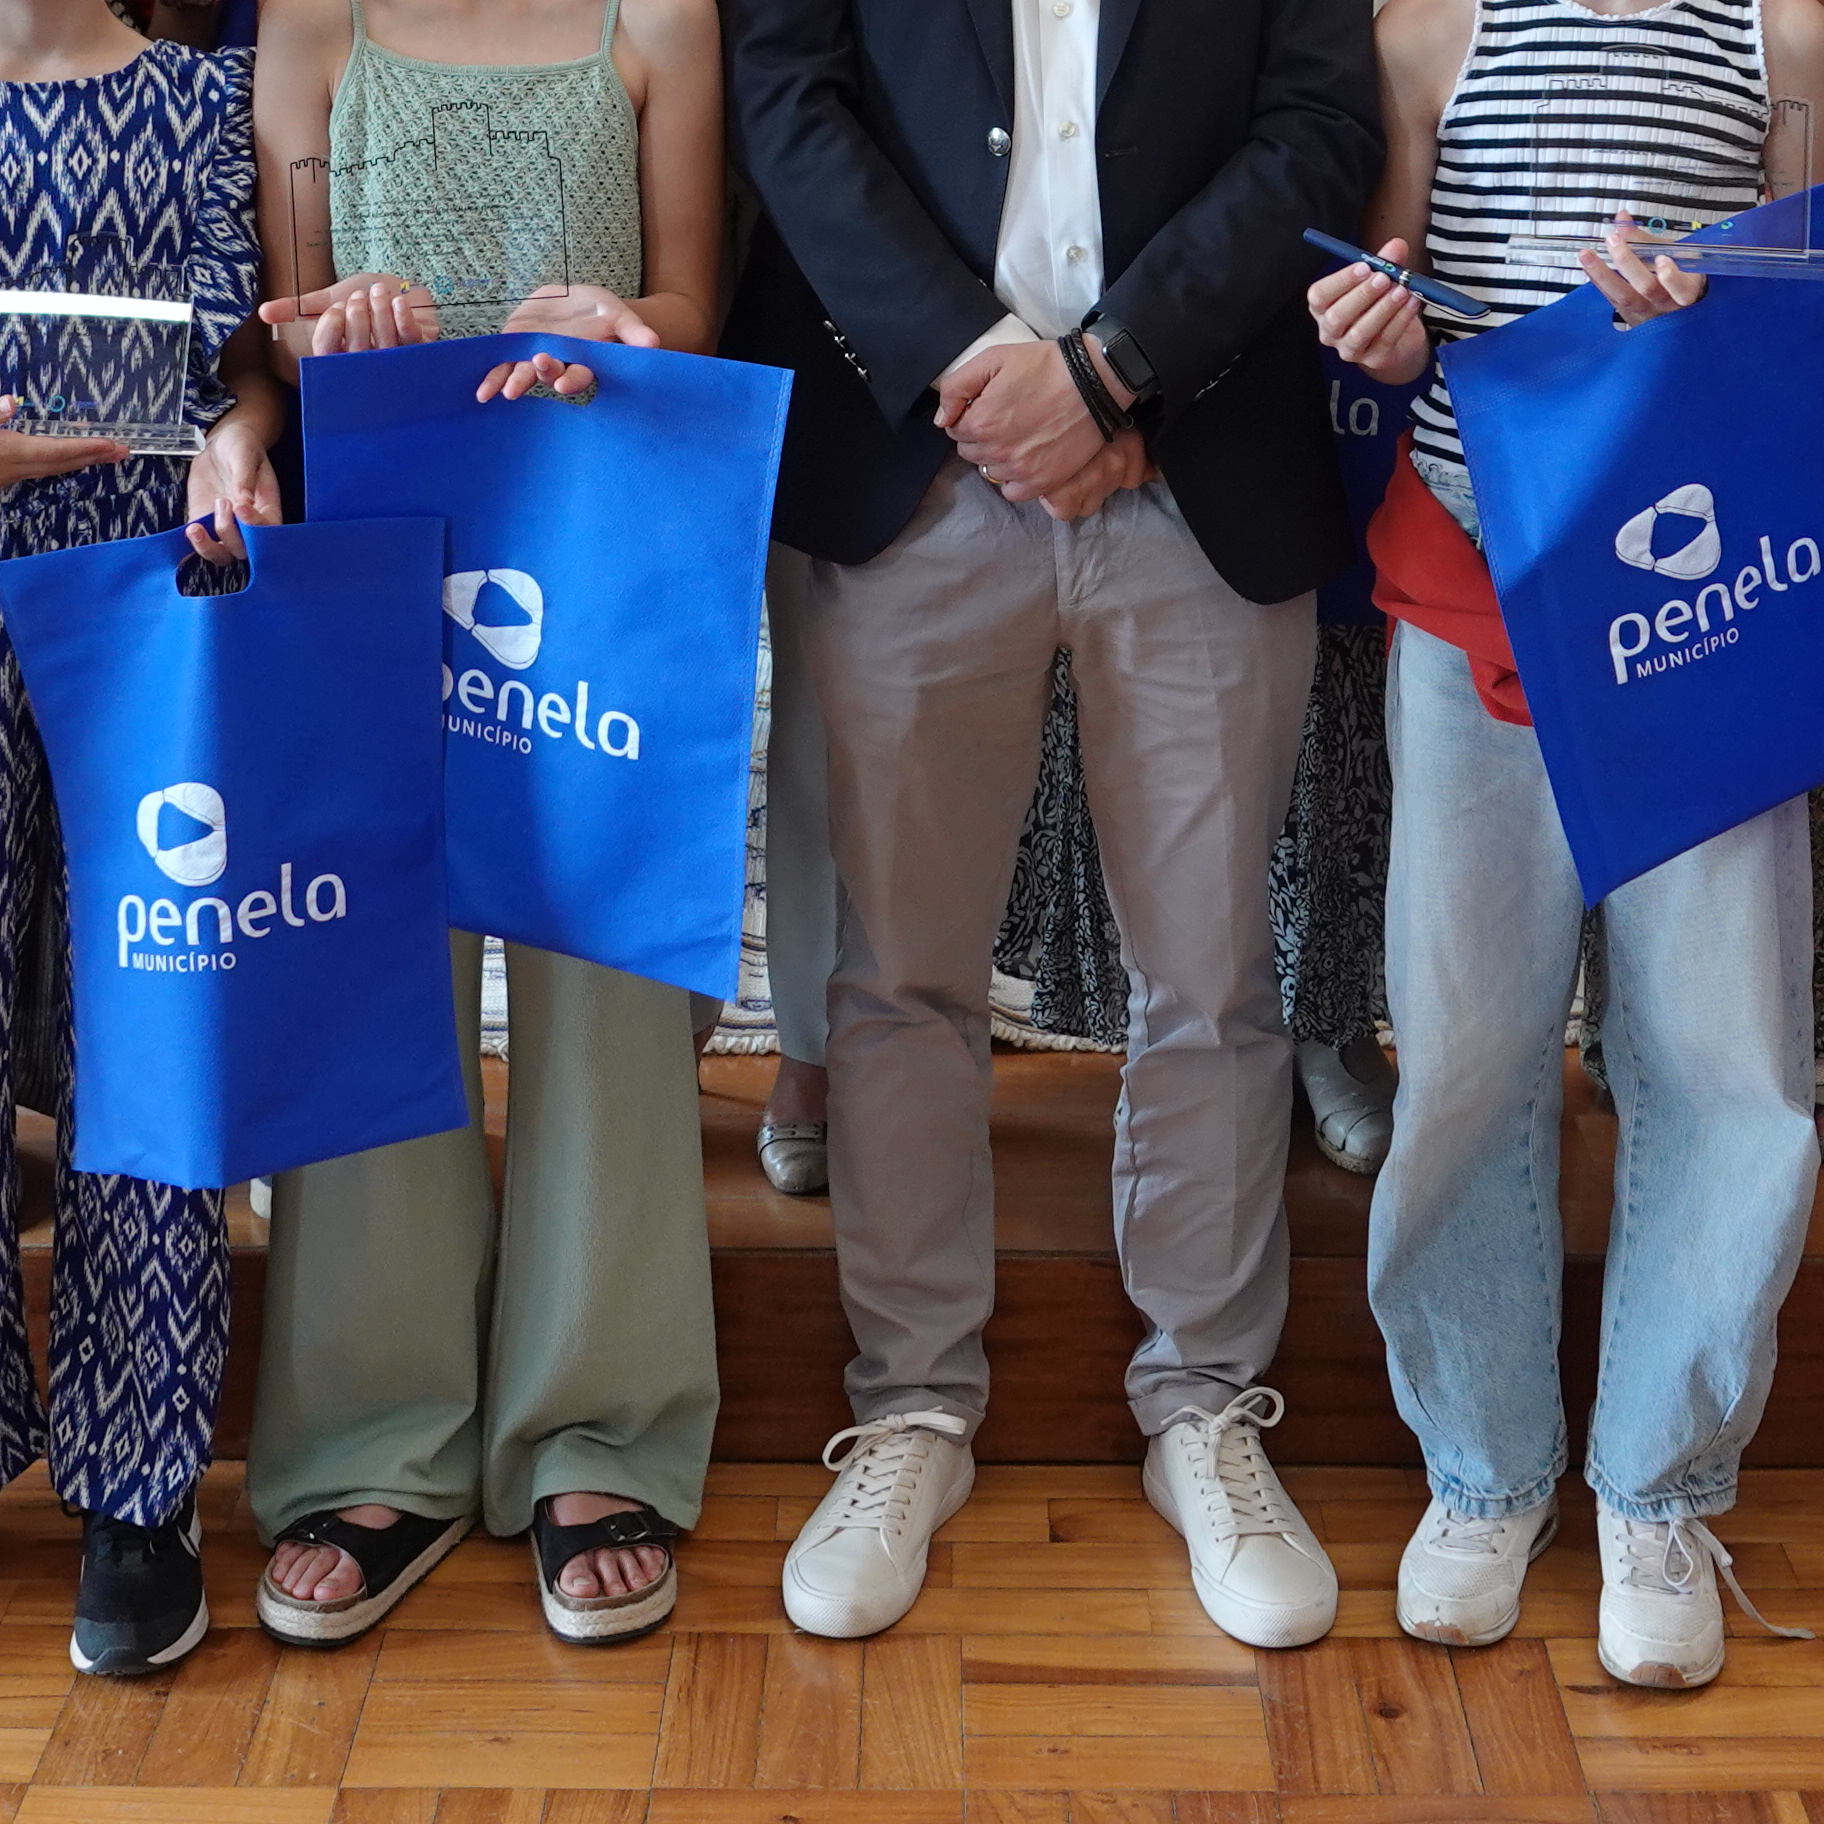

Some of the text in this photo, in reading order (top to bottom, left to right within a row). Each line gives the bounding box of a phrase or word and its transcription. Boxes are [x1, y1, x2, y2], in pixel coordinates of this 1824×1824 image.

[1608, 536, 1821, 685] penela
[1636, 627, 1739, 678] MUNICÍPIO
[442, 713, 533, 754] UNICÍPIO
[117, 862, 347, 969] penela
[132, 952, 237, 973] MUNICÍPIO
